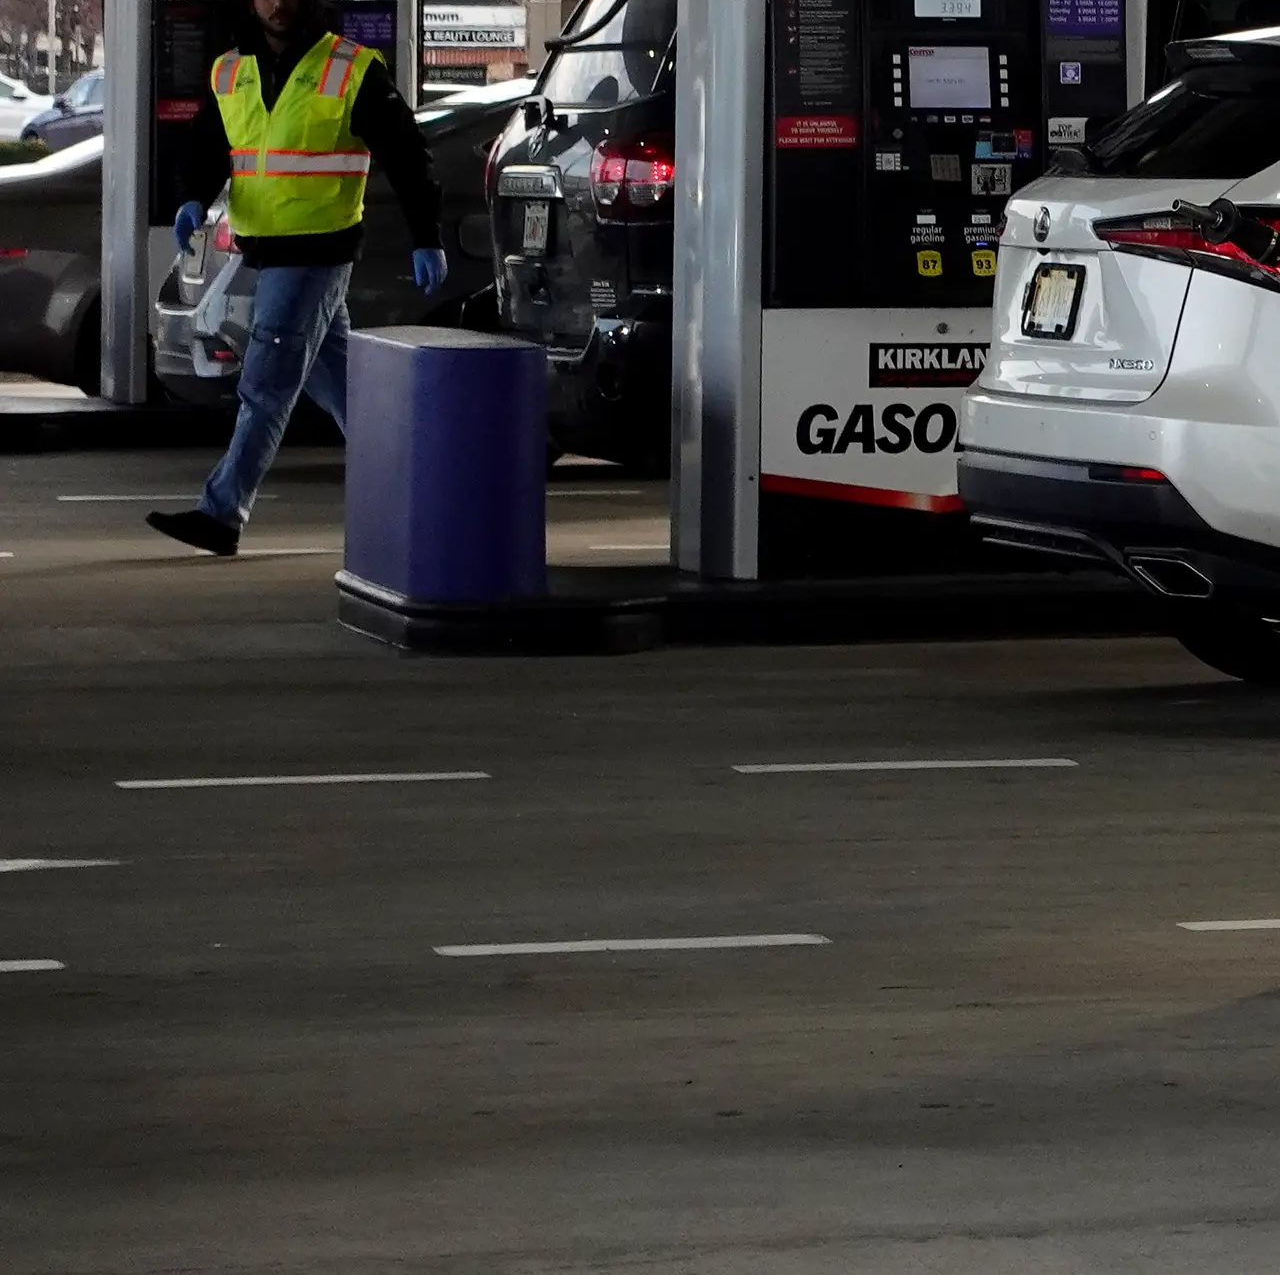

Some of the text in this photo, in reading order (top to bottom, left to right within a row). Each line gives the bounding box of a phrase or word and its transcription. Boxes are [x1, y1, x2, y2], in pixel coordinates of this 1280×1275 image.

[434, 30, 470, 42] BEAUTY
[472, 31, 514, 43] LOUNGE
[912, 225, 997, 236] regular premiu
[910, 233, 945, 244] gasoline
[922, 259, 992, 271] 87 93
[796, 402, 965, 456] GASO
